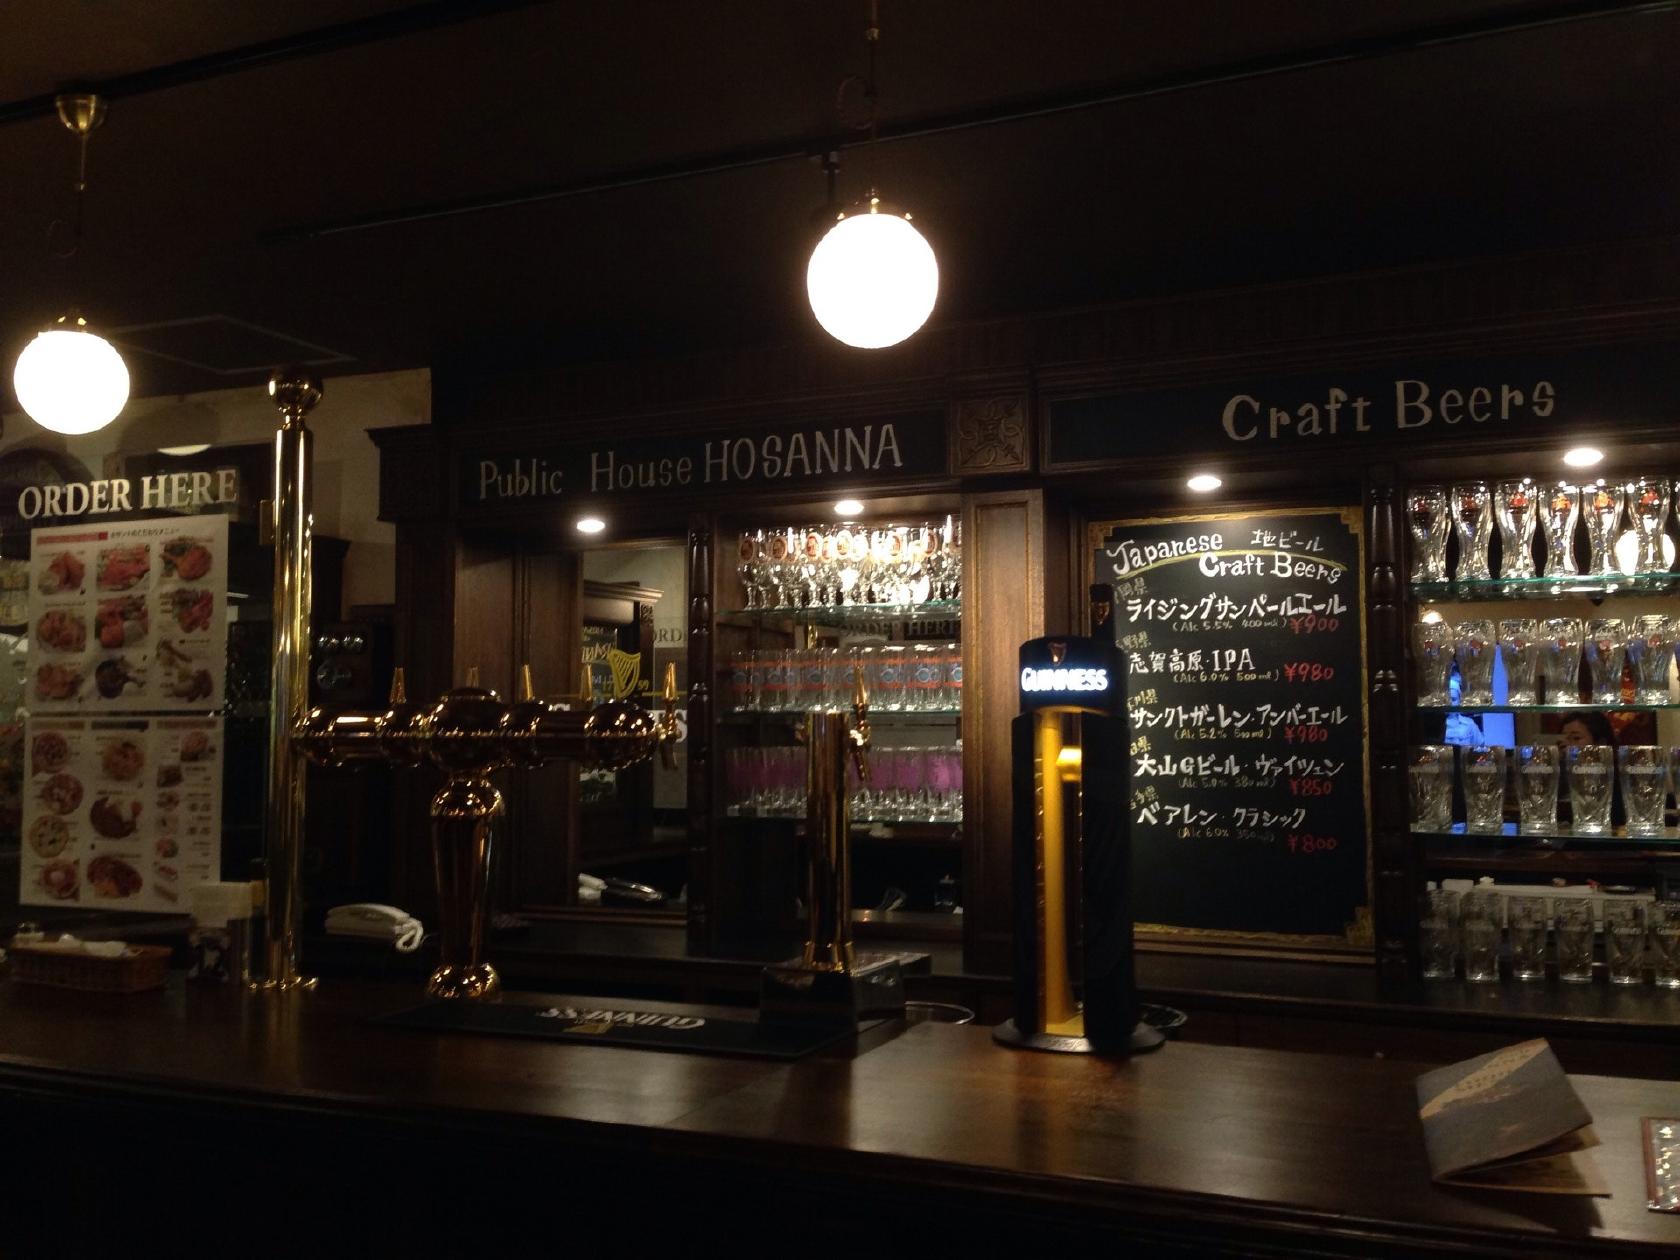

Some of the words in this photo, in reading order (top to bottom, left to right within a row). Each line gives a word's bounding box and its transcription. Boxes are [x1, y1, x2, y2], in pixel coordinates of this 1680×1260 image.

[1222, 387, 1371, 440] Craft
[1395, 380, 1555, 429] Beers
[480, 458, 563, 499] Public
[590, 450, 693, 492] House
[704, 423, 903, 483] HOSANNA
[18, 478, 133, 520] ORDER
[141, 469, 237, 510] HERE
[1107, 533, 1223, 575] Japanese
[1250, 529, 1324, 552] 地ビール
[1200, 552, 1265, 578] Craft
[1270, 551, 1342, 584] Beers
[1021, 667, 1108, 692] GUINNESS
[1283, 663, 1335, 683] ¥980
